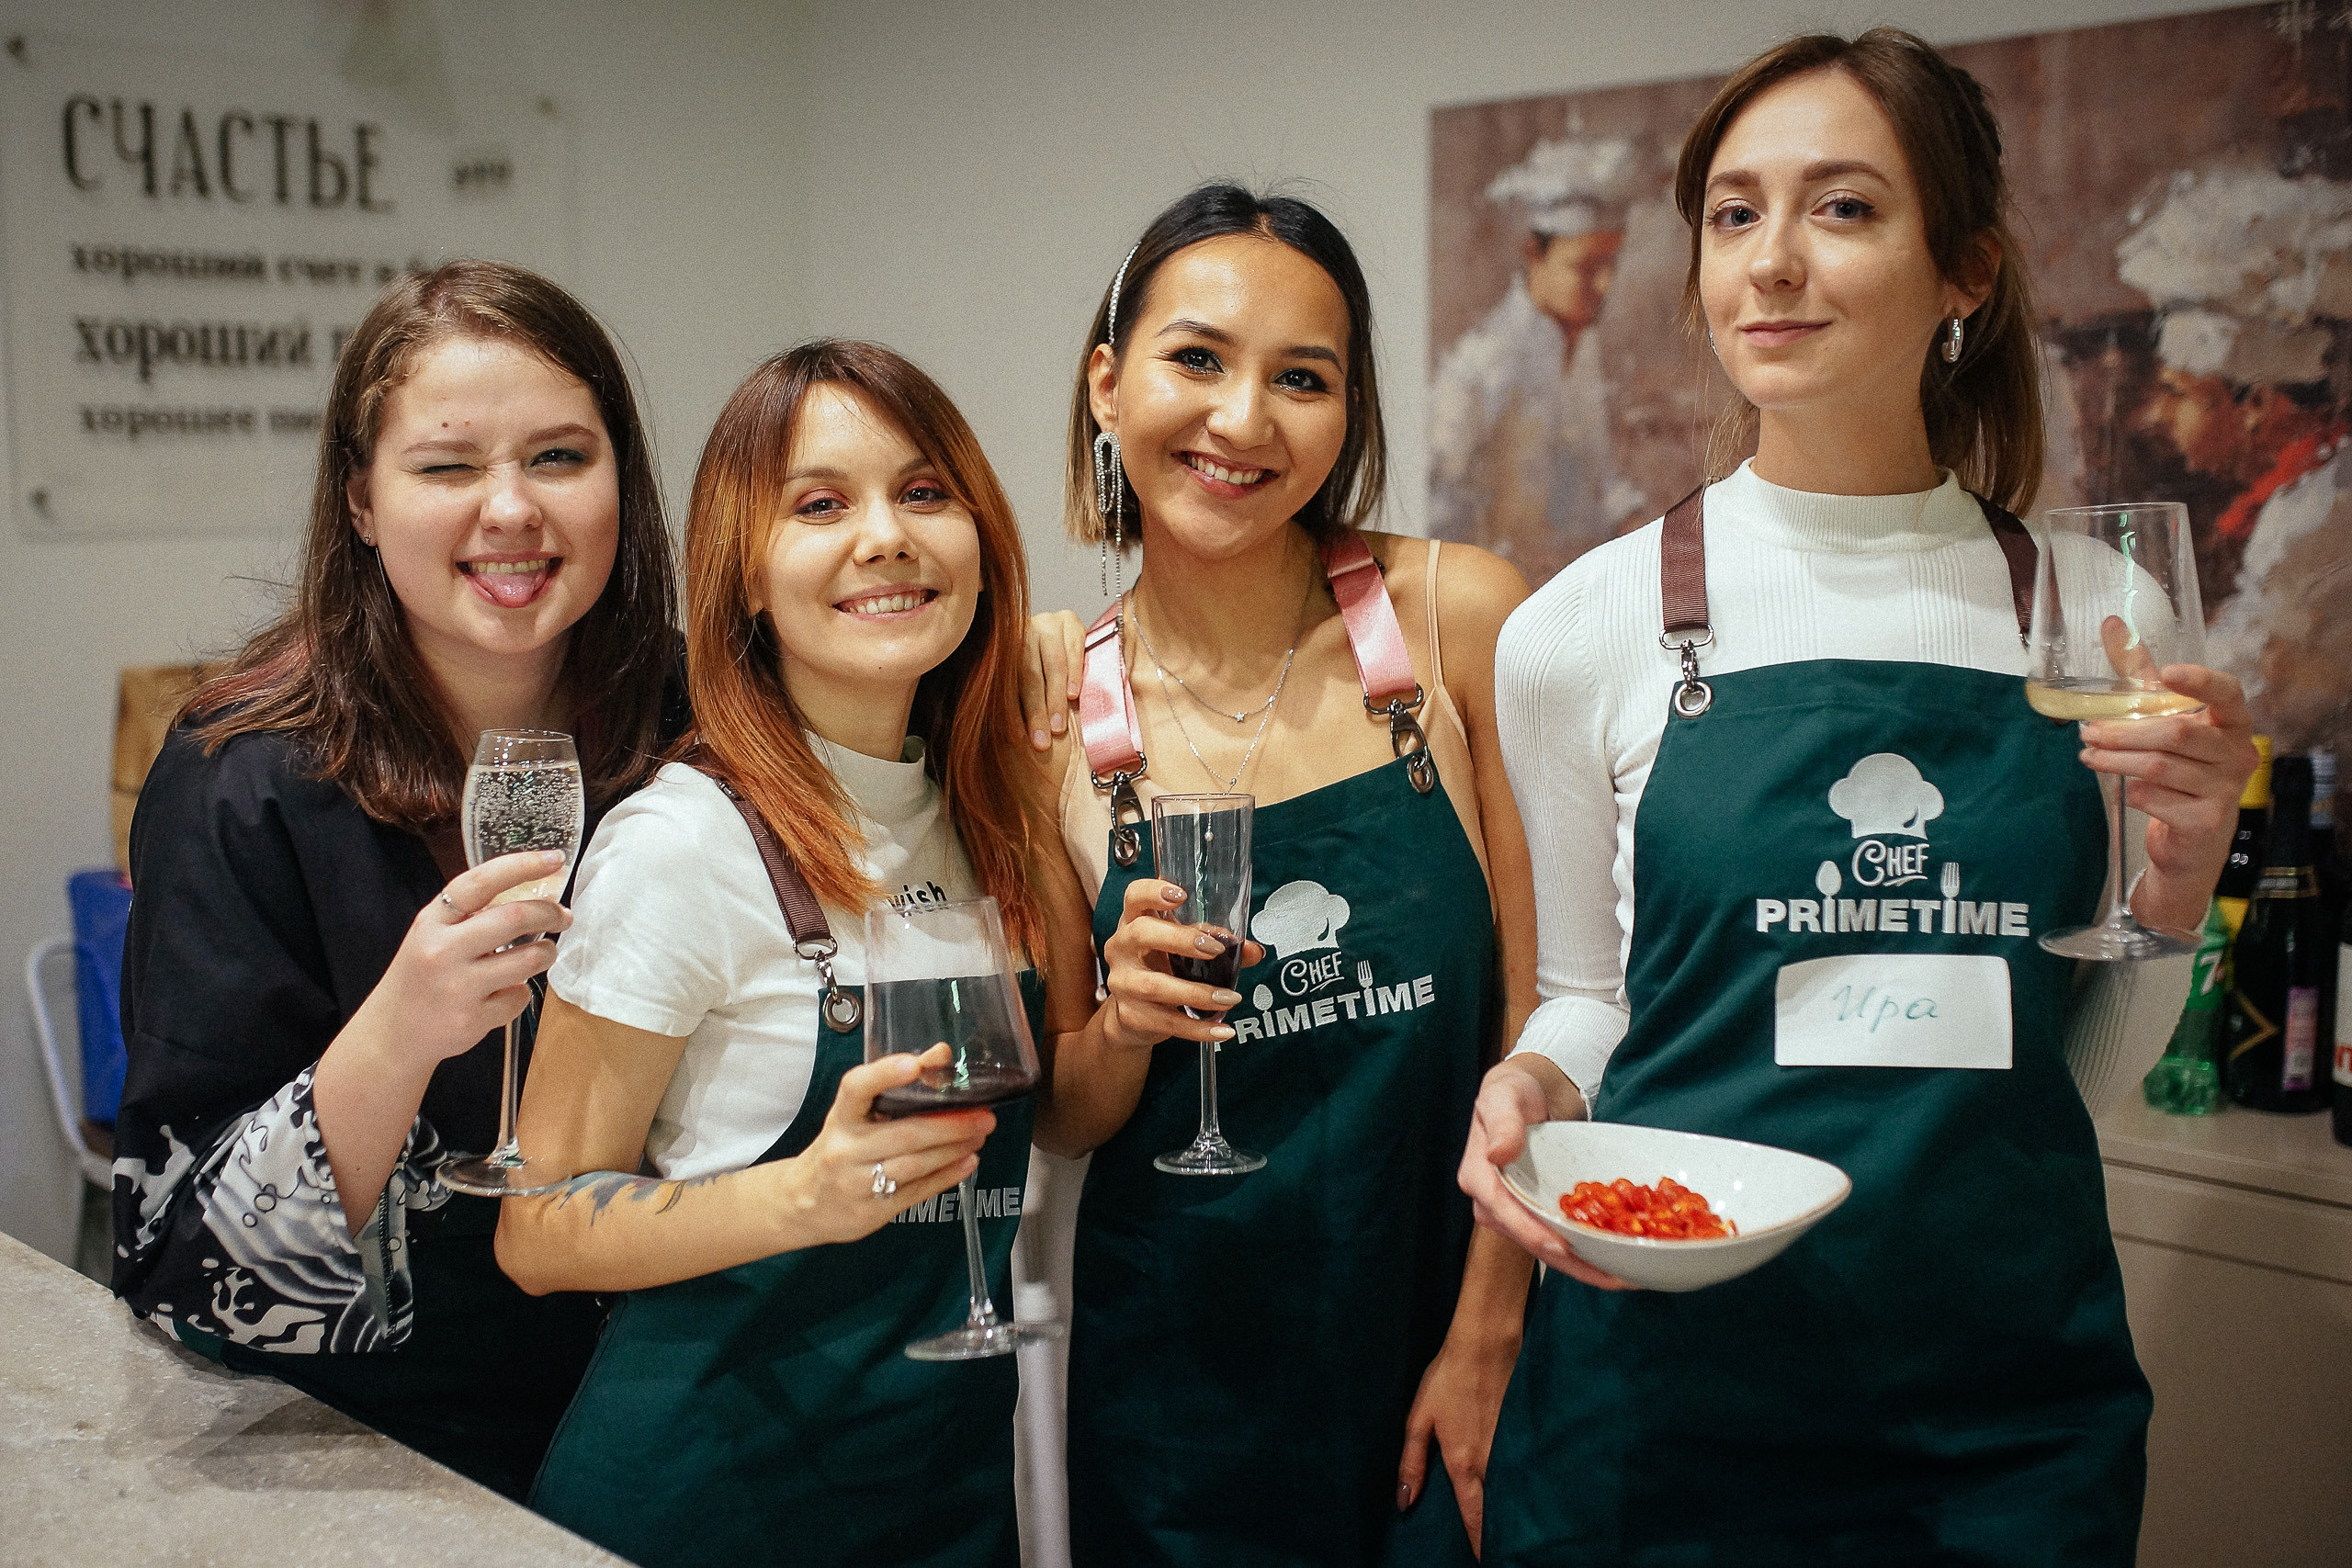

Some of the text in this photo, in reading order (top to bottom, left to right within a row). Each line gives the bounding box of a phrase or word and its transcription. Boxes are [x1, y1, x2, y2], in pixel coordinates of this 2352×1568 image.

[62, 94, 393, 213] СЧАСТЬЕ
[74, 314, 311, 382] хороший
[1756, 897, 2030, 937] PRIMETIME
[1833, 985, 1939, 1033] Ира
